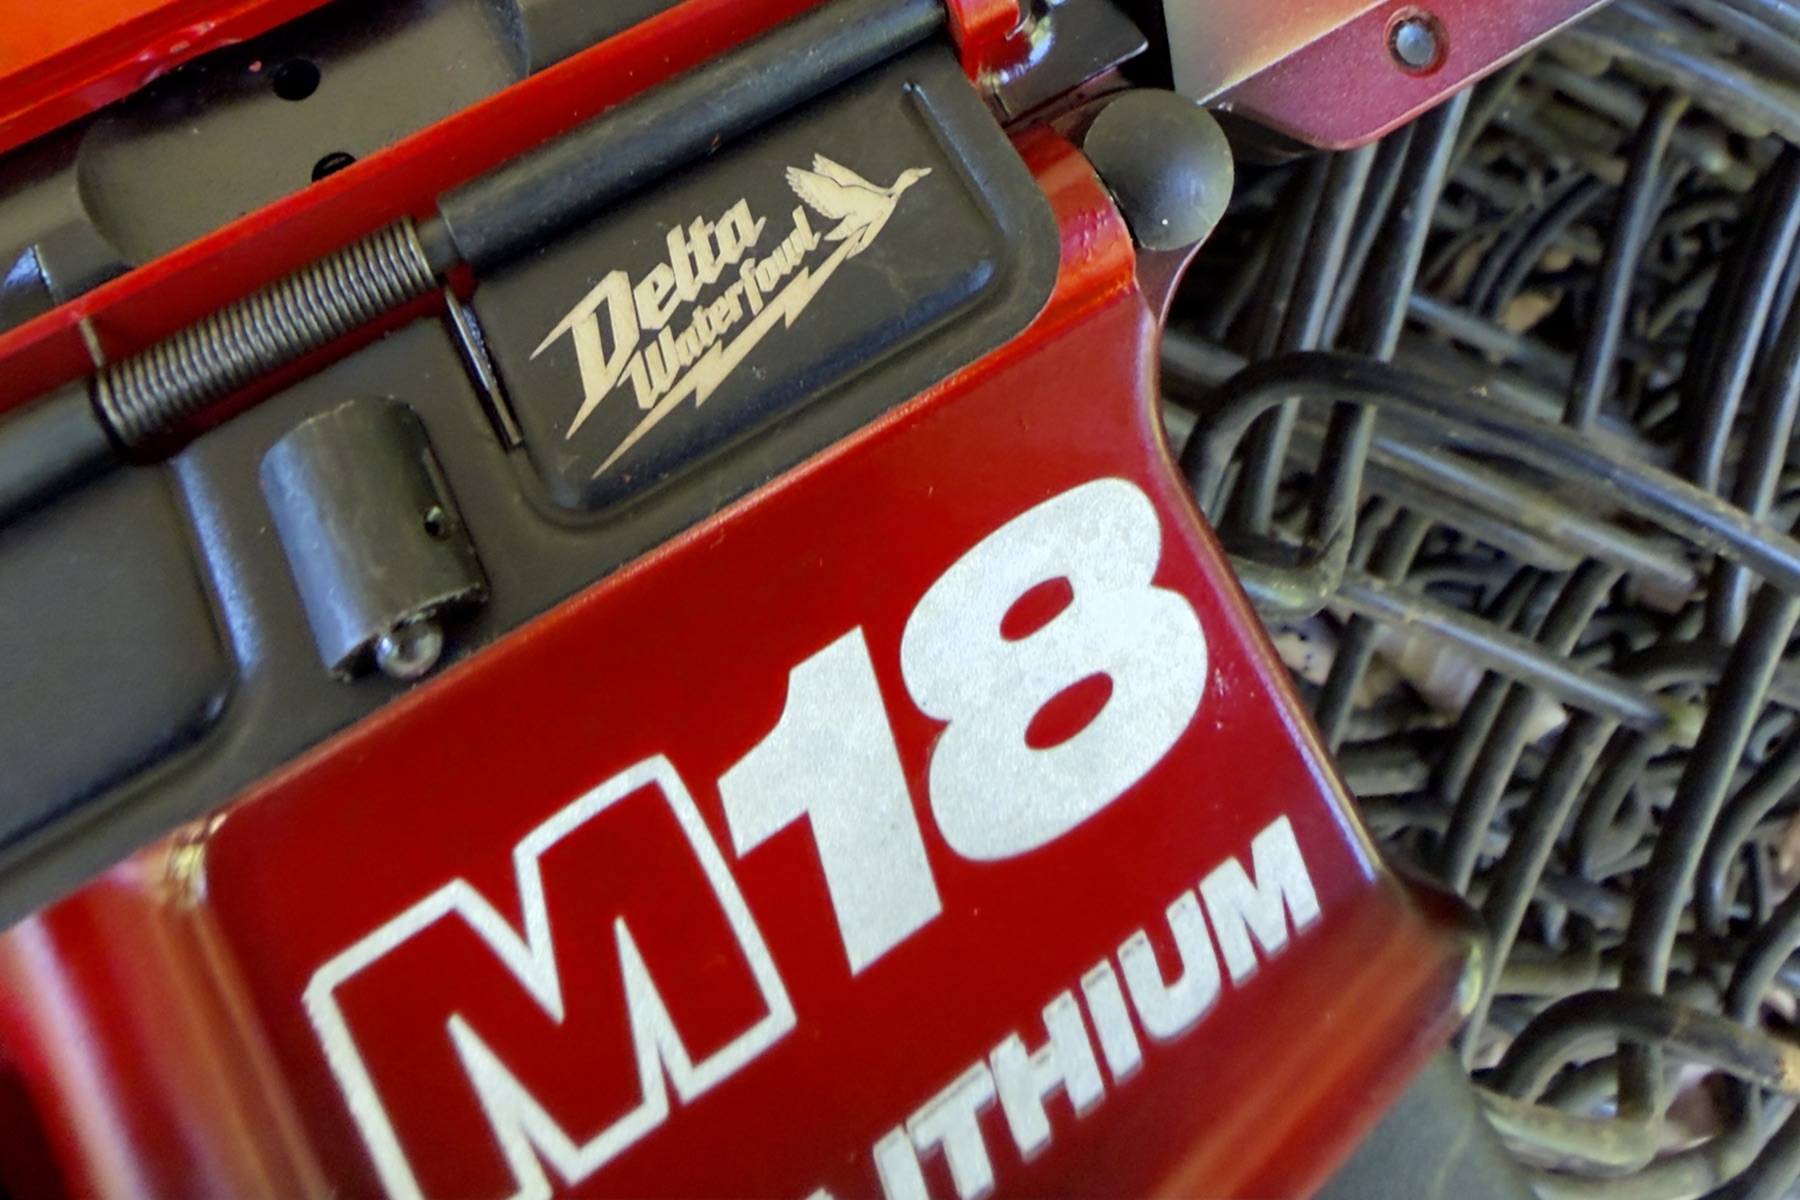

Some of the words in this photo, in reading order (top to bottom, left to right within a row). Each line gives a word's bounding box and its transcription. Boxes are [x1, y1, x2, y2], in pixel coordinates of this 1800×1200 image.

[529, 197, 767, 440] Delta
[616, 204, 821, 409] Waterfowl
[304, 477, 1208, 1200] M18
[803, 814, 1322, 1200] ITHIUM
